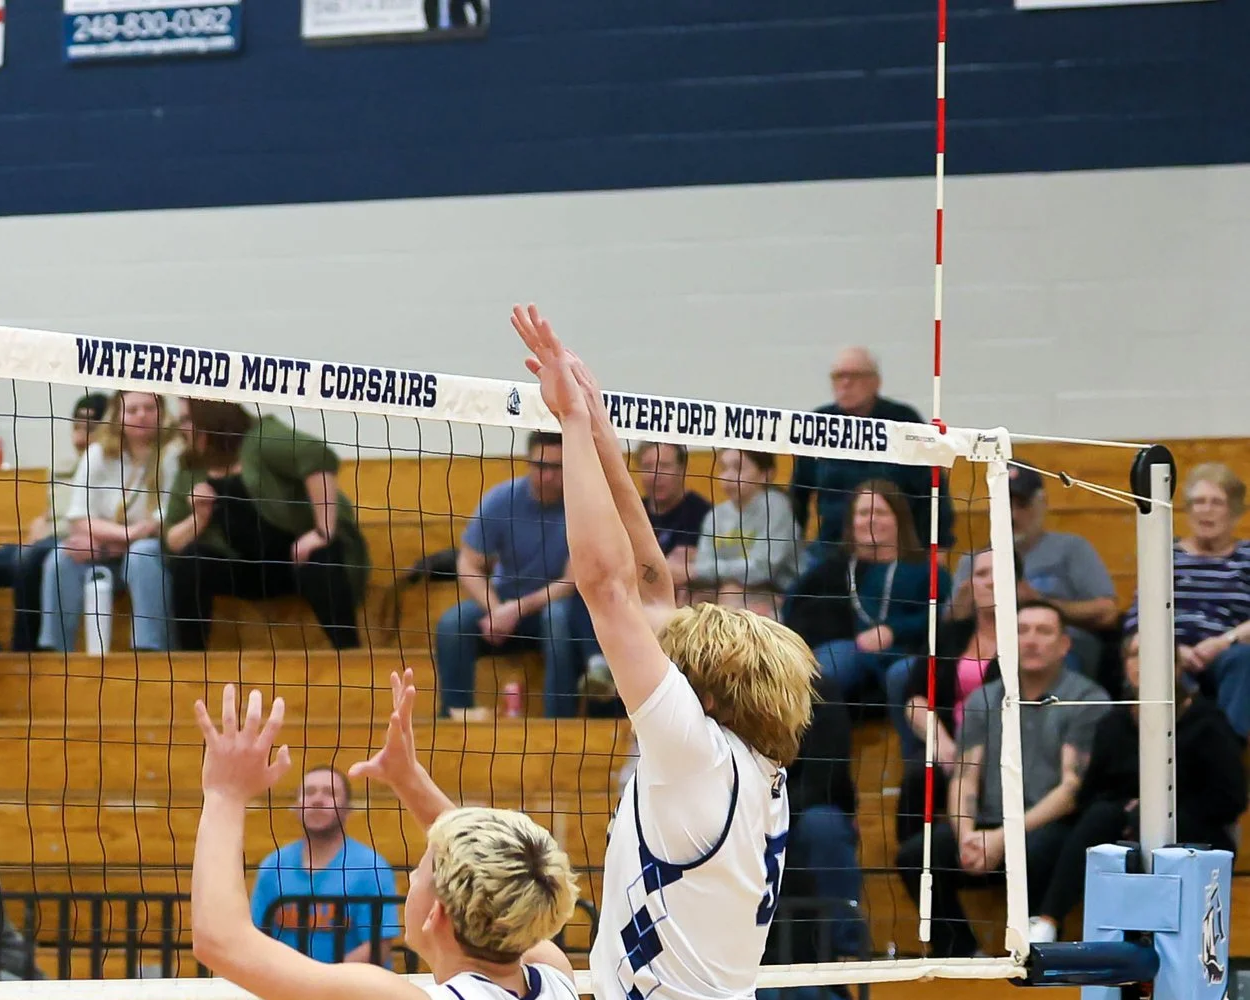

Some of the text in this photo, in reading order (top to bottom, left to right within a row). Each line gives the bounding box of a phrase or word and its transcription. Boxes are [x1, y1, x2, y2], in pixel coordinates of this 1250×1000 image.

[76, 337, 437, 408] WATERFORD MOTT CORSAIRS
[602, 393, 888, 452] ATERFORD MOTT CORSAIRS
